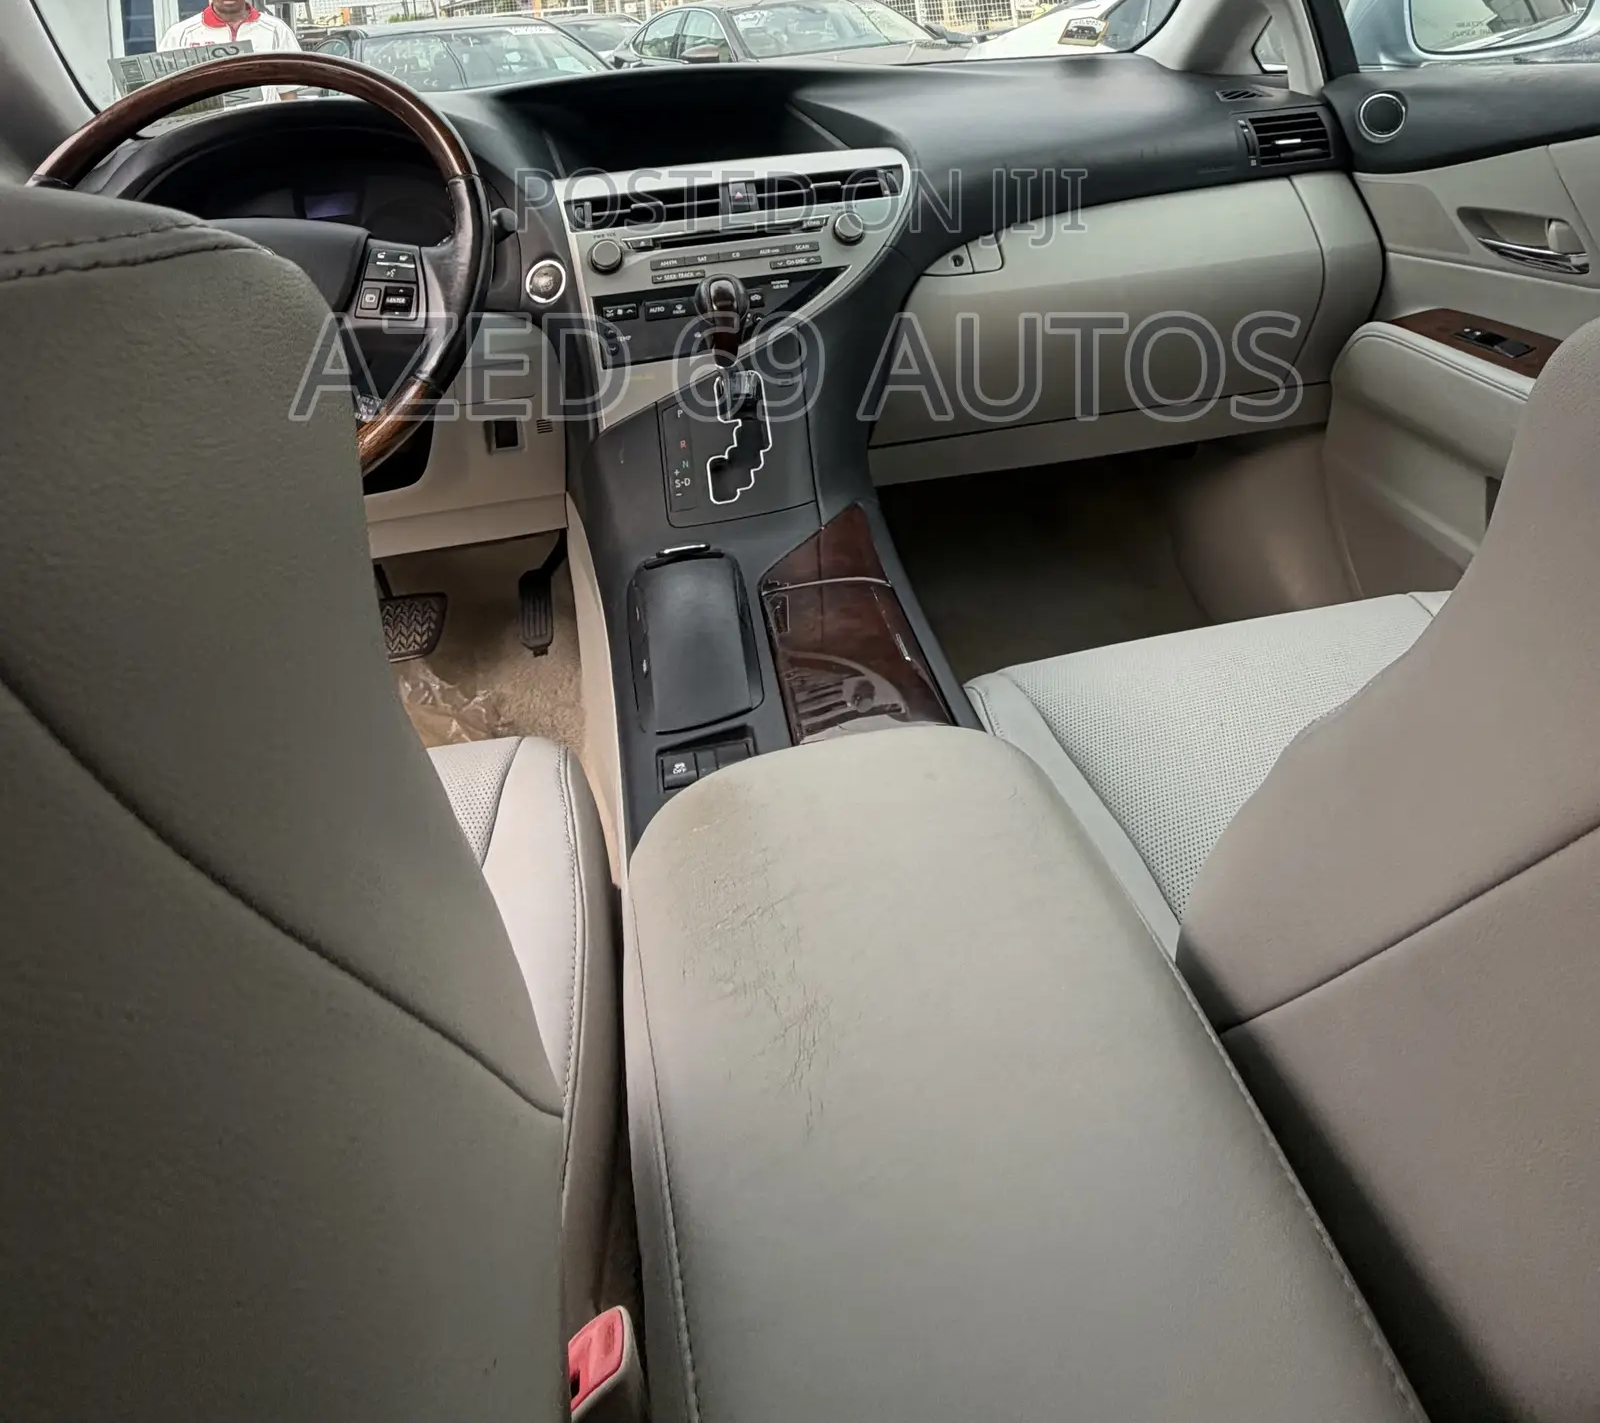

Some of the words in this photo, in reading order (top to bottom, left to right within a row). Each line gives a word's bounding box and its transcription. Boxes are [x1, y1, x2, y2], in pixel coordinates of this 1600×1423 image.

[649, 305, 665, 313] AUTO
[676, 409, 684, 418] P
[680, 440, 687, 449] R
[682, 460, 689, 468] N
